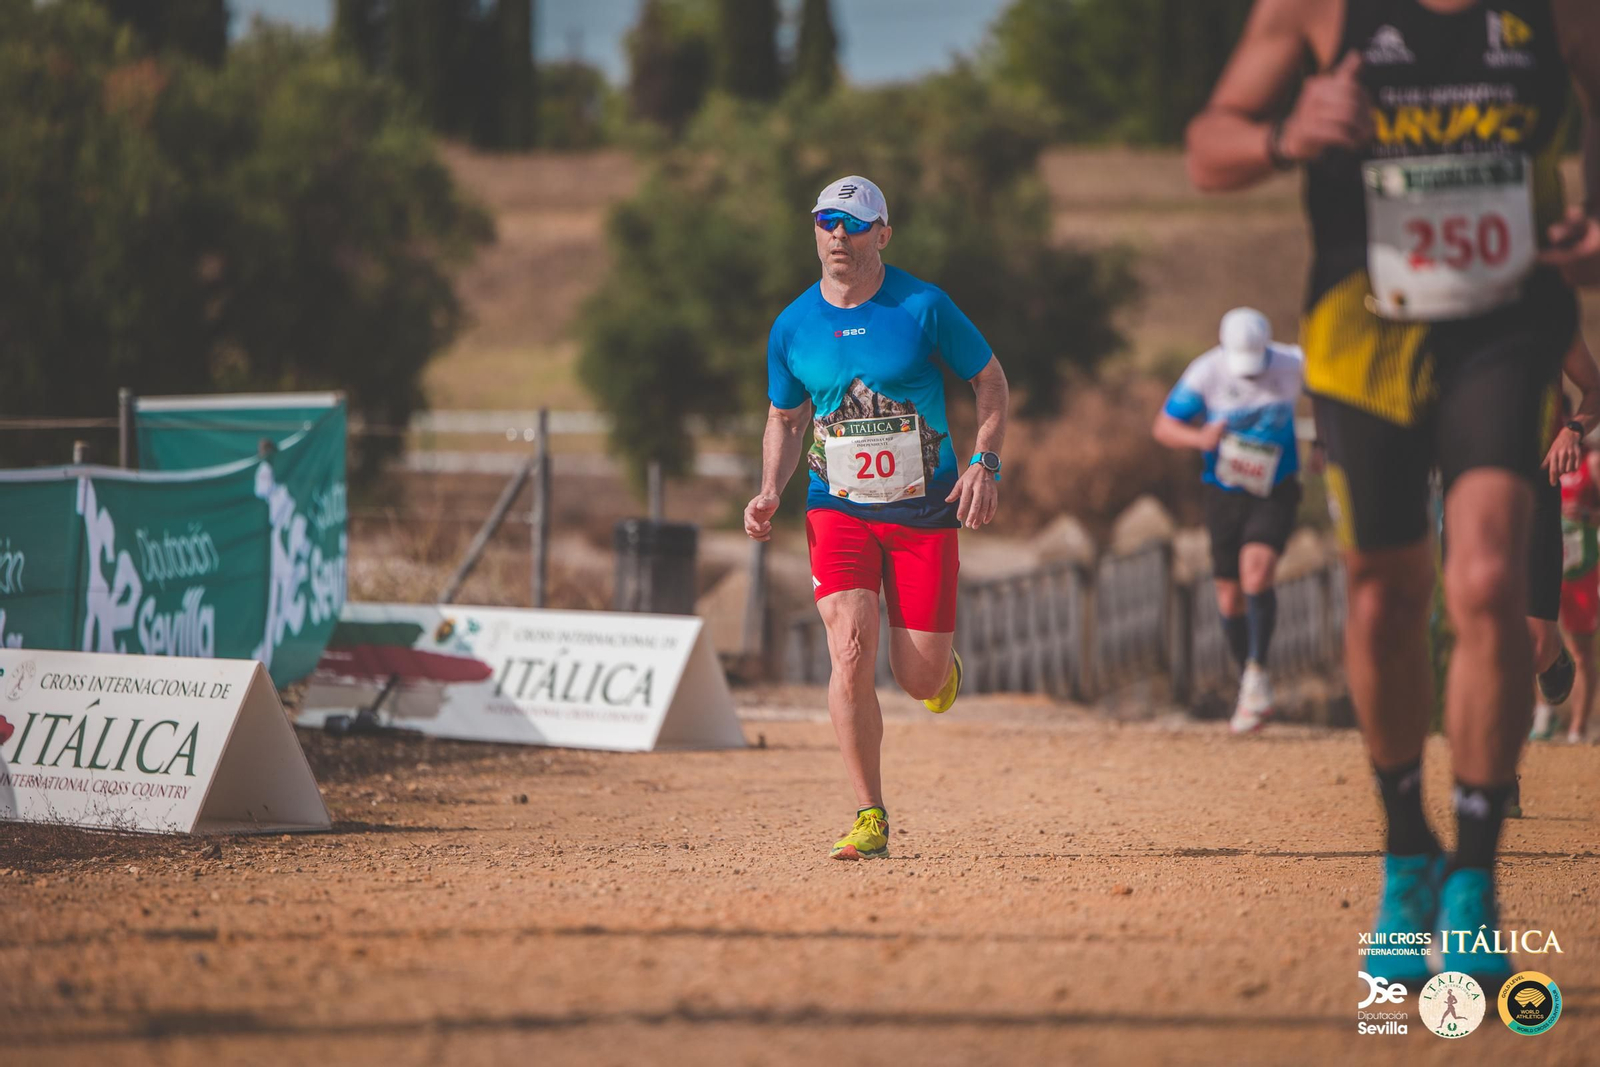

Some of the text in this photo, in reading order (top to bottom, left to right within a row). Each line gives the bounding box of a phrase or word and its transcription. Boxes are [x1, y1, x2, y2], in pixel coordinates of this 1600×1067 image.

[1406, 211, 1513, 272] 250
[849, 421, 893, 433] ITÁLICA
[855, 450, 895, 479] 20
[138, 585, 215, 657] Sevilla
[40, 672, 87, 691] CROSS
[88, 675, 206, 698] INTERNACIONAL
[210, 682, 232, 699] DE
[493, 647, 655, 706] ITÁLICA
[8, 698, 199, 777] ITÁLICA
[0, 772, 191, 799] INTERNATIONAL CROSS COUNTRY
